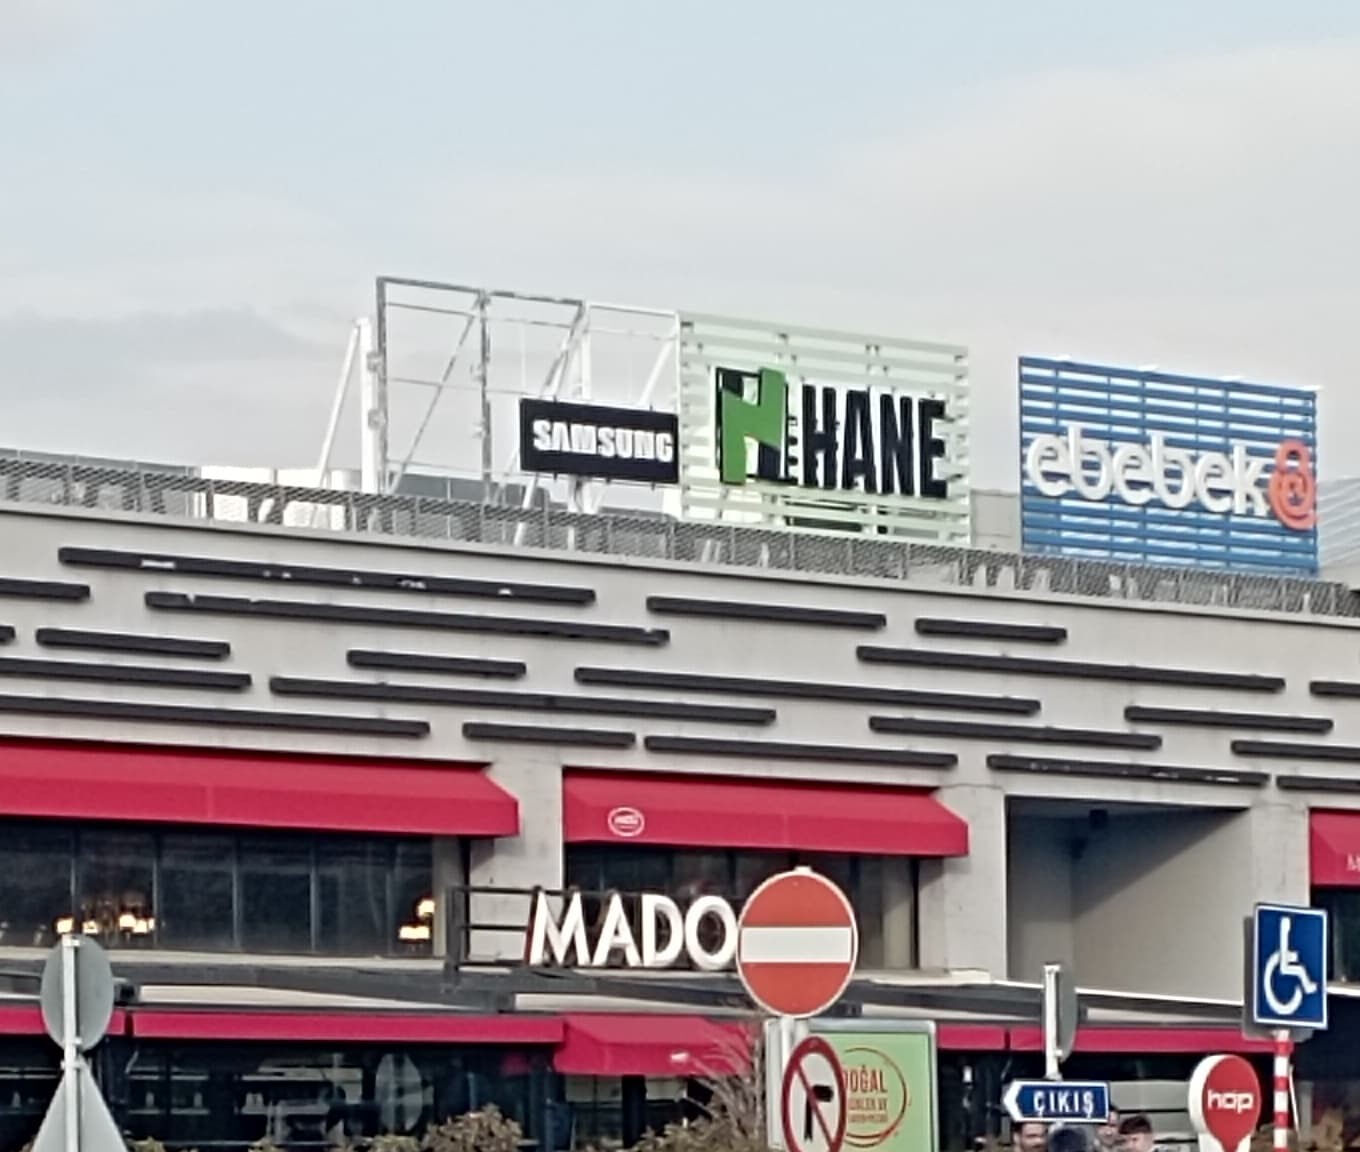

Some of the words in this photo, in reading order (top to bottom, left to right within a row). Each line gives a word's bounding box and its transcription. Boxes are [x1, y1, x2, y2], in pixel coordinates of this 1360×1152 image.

[533, 419, 674, 463] SAMSUNG
[1026, 425, 1269, 517] ebebek
[528, 889, 739, 971] MADO
[1033, 1090, 1094, 1120] ÇIKIŞ
[1207, 1089, 1254, 1114] hop
